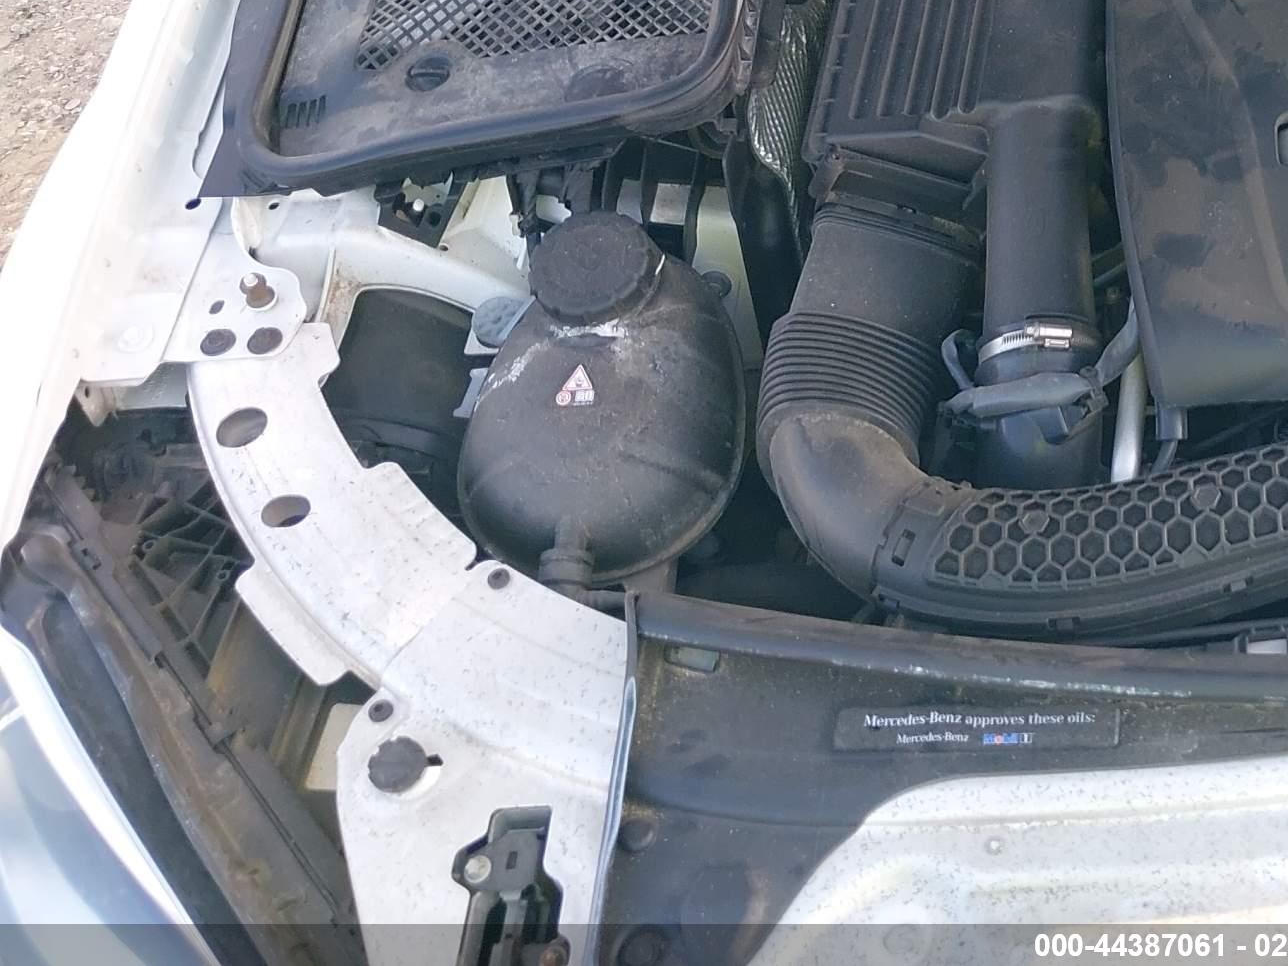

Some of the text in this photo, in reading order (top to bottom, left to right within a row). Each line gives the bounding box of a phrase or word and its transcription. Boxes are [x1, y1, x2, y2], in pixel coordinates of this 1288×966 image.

[863, 711, 1096, 728] Mercedes-Benz approves these oils:
[896, 731, 969, 745] Mercedes-Benz
